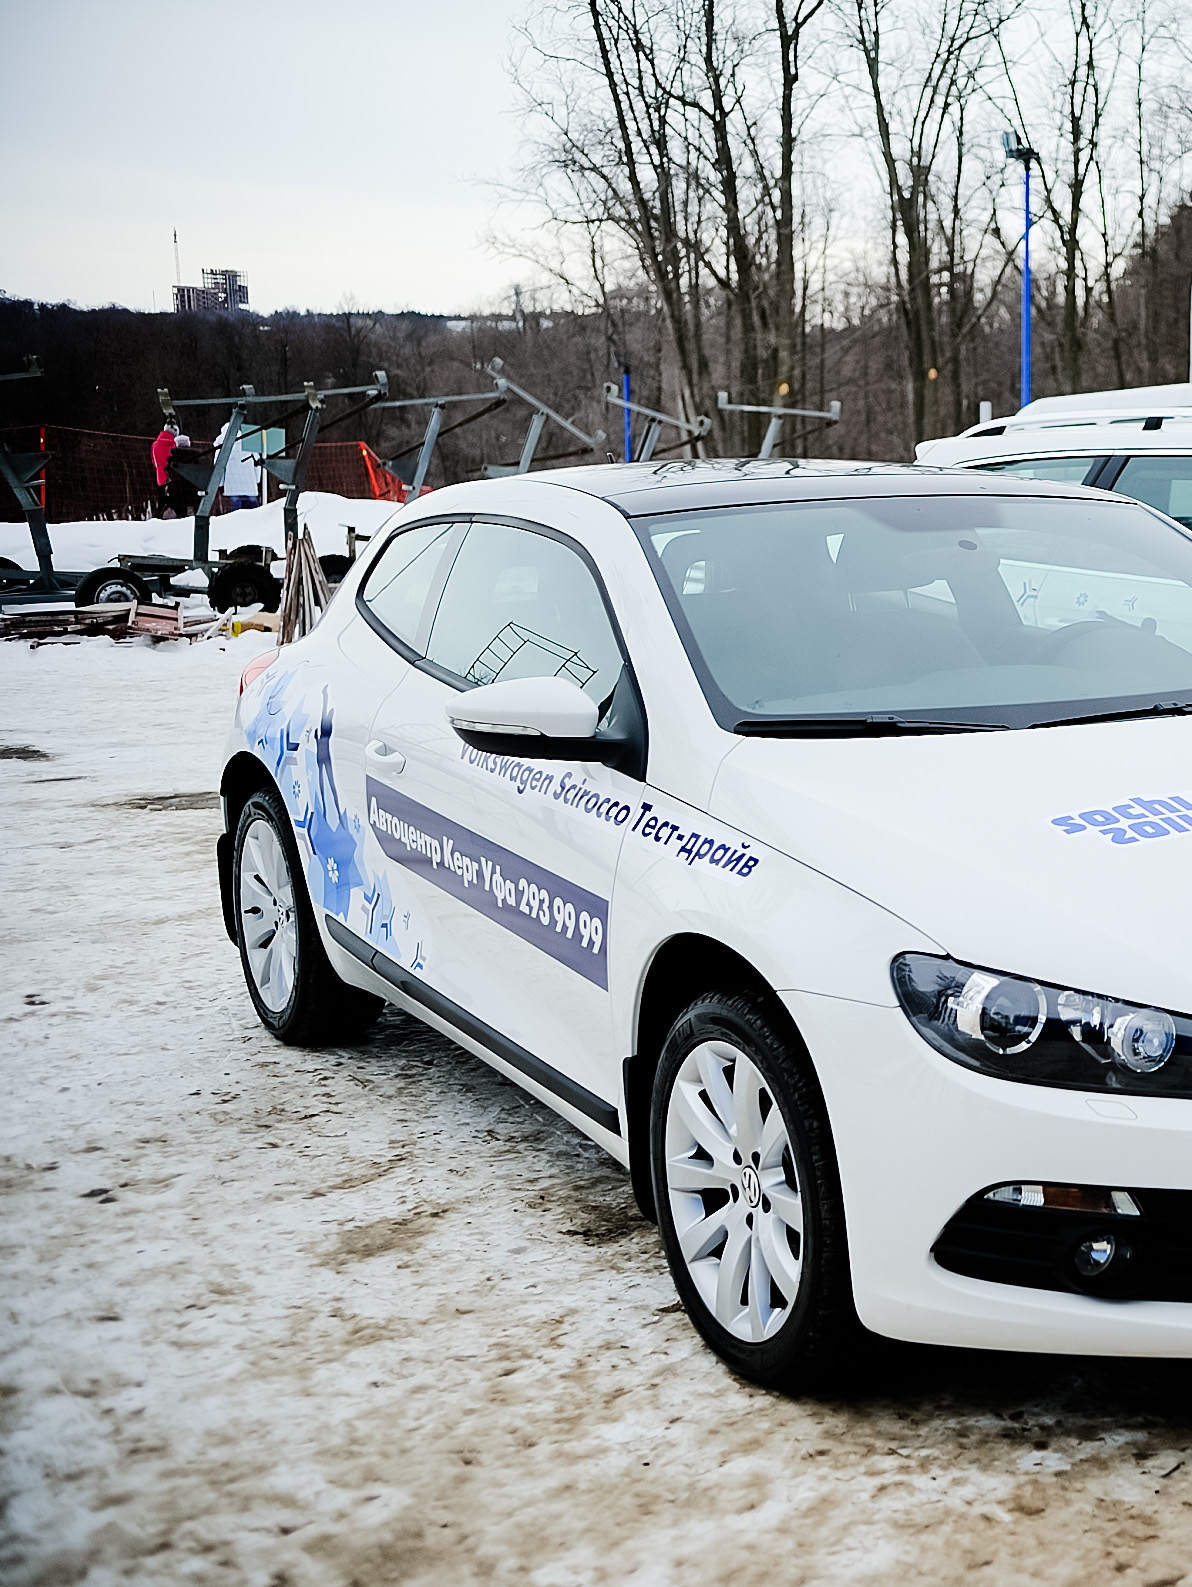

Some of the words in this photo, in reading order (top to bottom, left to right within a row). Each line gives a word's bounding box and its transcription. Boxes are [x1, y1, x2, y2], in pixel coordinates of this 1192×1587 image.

[370, 796, 442, 870] Автоцентр
[443, 835, 479, 888] Керг
[480, 856, 516, 908] Уфа
[518, 878, 550, 926] 293
[553, 896, 576, 939] 99
[579, 911, 603, 954] 99
[553, 771, 631, 826] Scirocco
[631, 802, 760, 877] Тест-драйв
